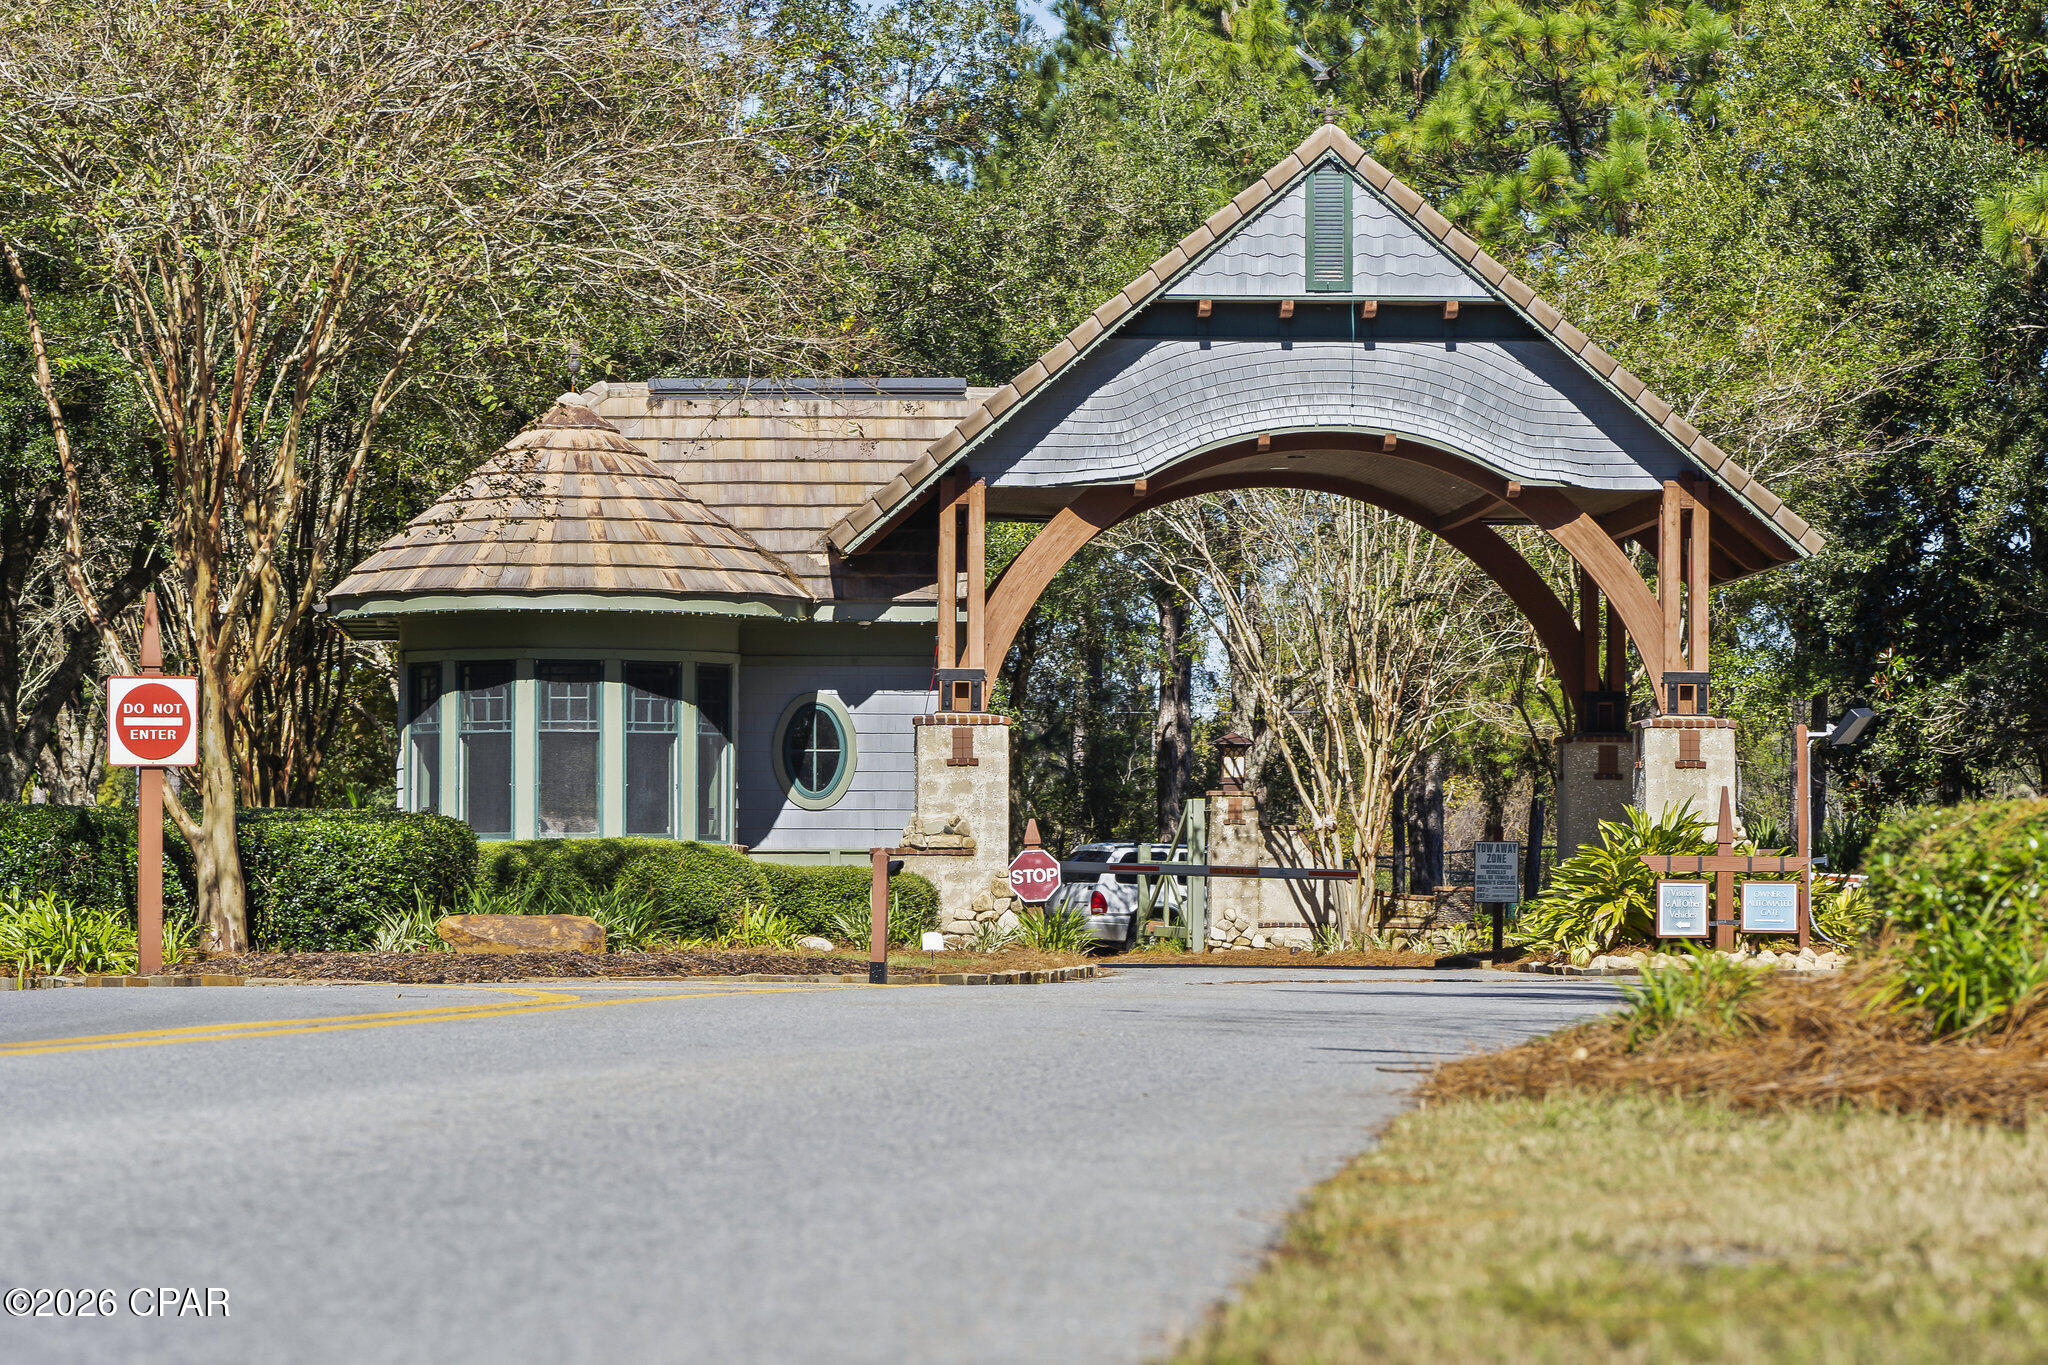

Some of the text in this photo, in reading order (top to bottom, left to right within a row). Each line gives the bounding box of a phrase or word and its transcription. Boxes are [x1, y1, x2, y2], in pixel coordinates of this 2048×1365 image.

[123, 703, 183, 714] DO NOT
[130, 729, 176, 740] ENTER
[1477, 843, 1517, 853] TOW AWAY
[1486, 853, 1507, 863] ZONE
[1011, 867, 1058, 885] STOP
[1670, 888, 1696, 897] Visitors
[1753, 890, 1787, 898] OWNER'S
[1671, 899, 1682, 908] All
[1682, 899, 1700, 908] Other
[1747, 899, 1793, 907] AUTOMATED
[1669, 910, 1697, 919] Vehicles
[1759, 908, 1780, 916] GATE
